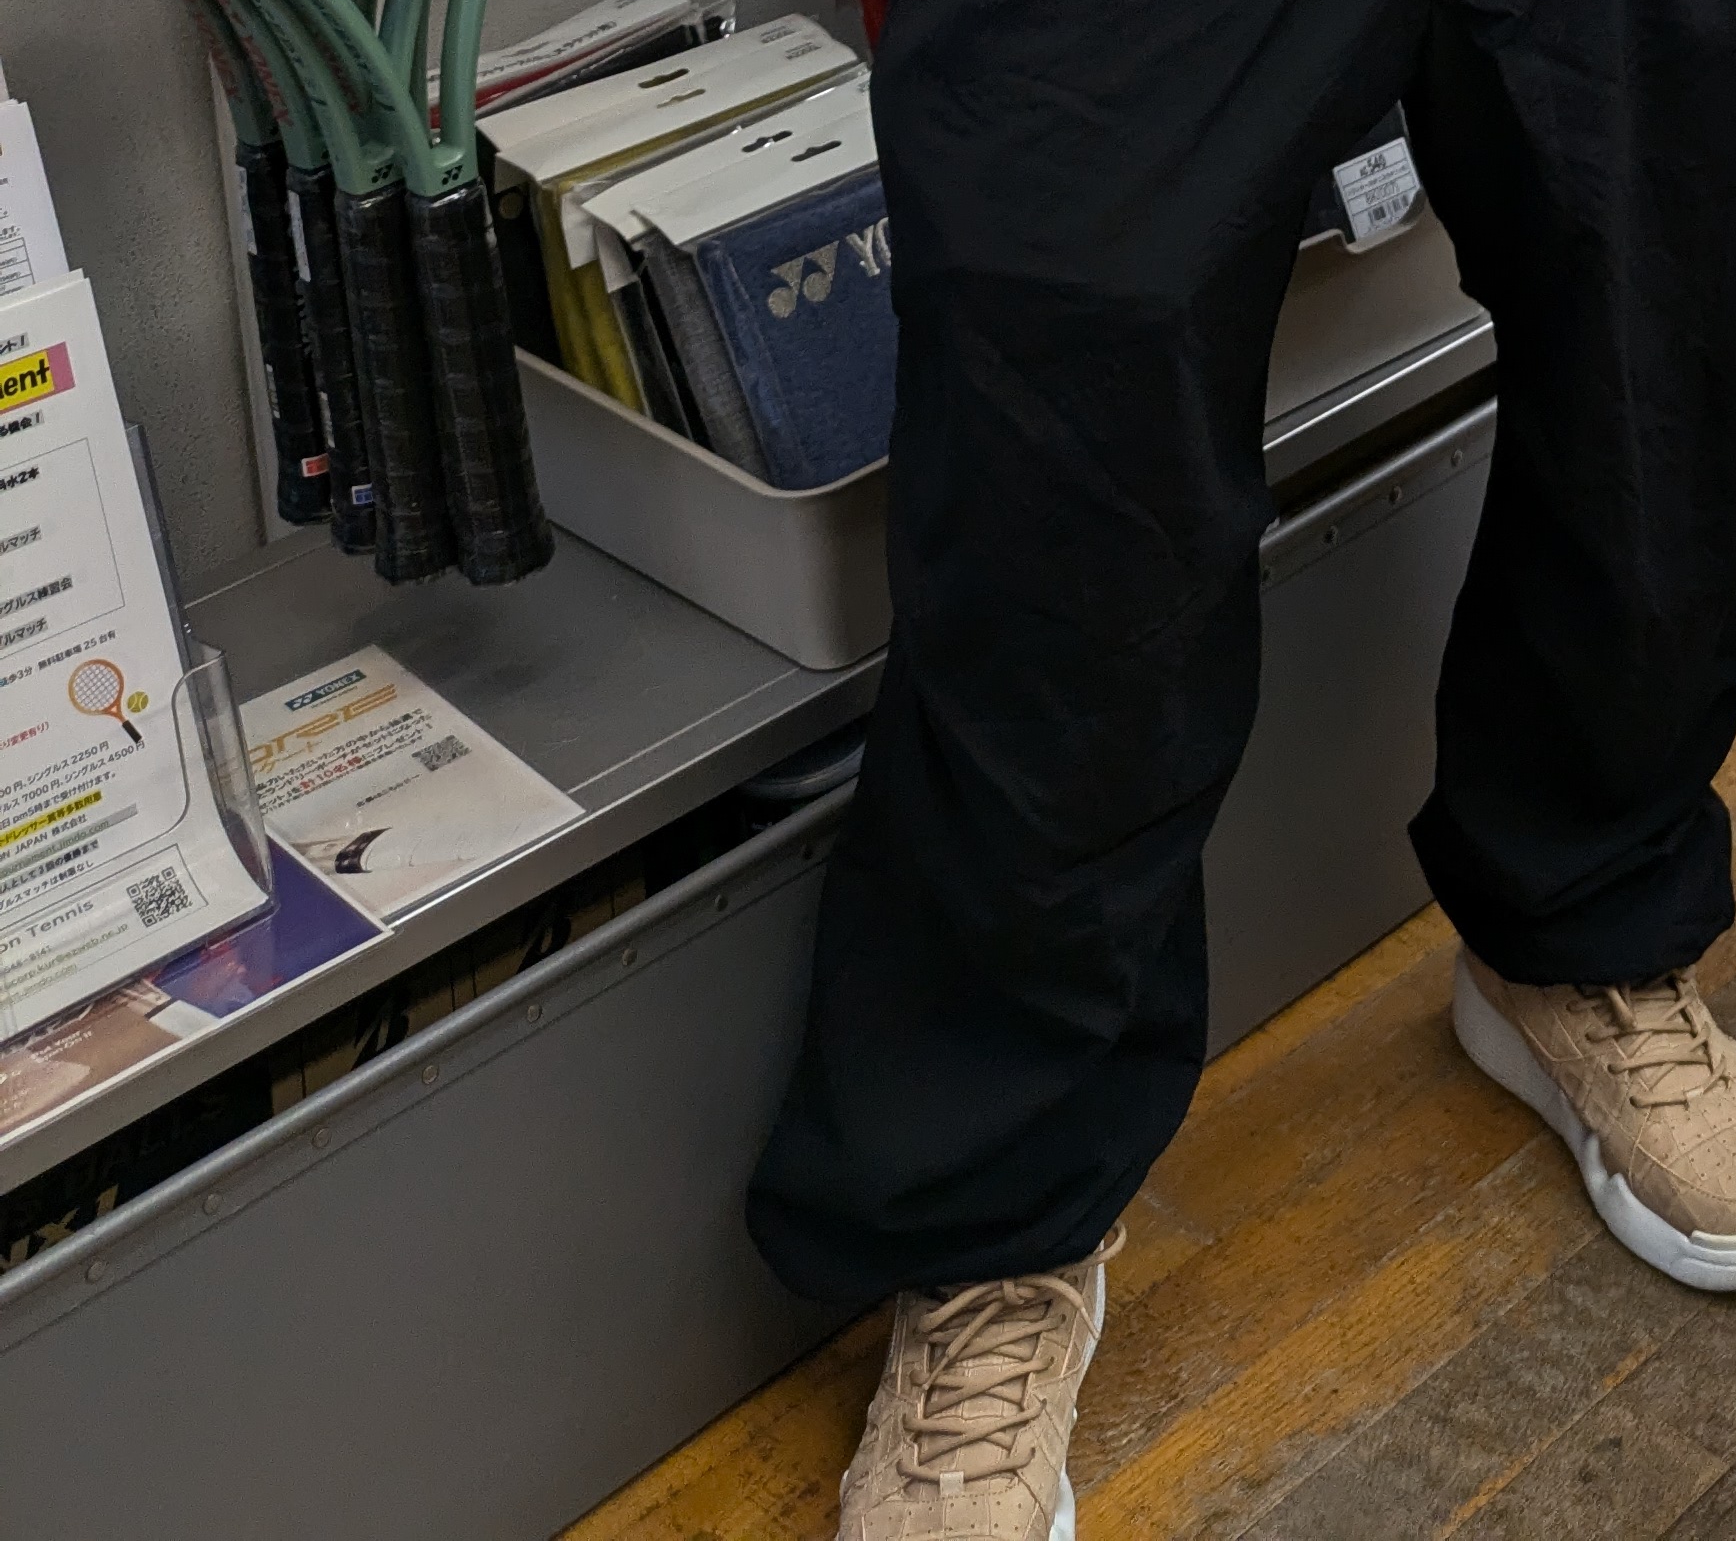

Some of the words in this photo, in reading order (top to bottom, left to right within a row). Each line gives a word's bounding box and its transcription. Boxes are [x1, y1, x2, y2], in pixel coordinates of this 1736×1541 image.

[84, 637, 97, 651] 25
[22, 784, 49, 804] 7000
[107, 744, 135, 765] 4500
[135, 739, 146, 752] 円
[71, 744, 98, 764] 2250
[99, 740, 110, 752] 円
[15, 832, 48, 859] JAPAN
[51, 813, 88, 838] 株式会社
[26, 899, 95, 940] Tennis
